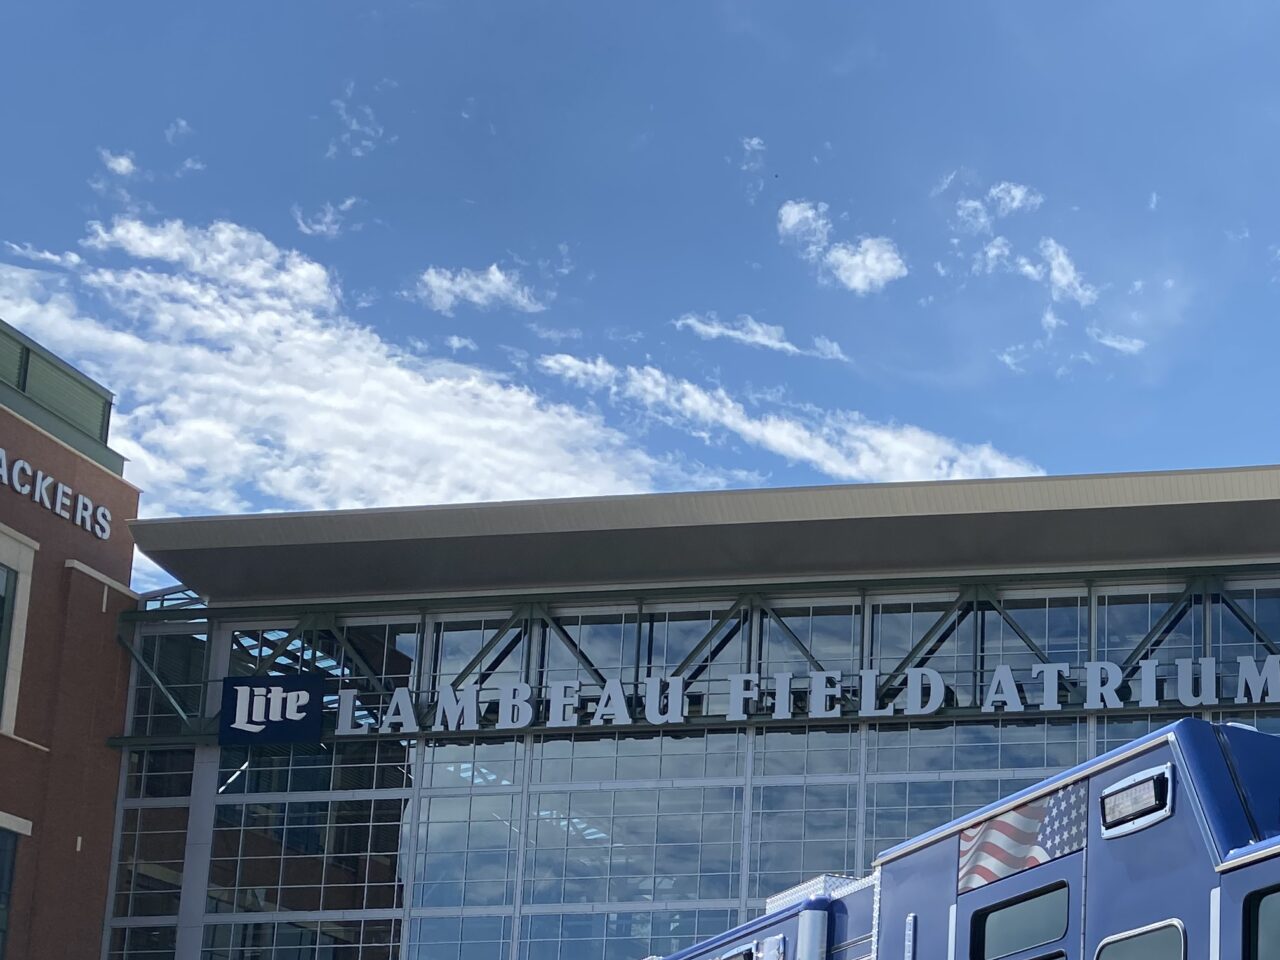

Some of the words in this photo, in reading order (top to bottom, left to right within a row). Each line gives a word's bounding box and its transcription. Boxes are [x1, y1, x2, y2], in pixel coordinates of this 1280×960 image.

[230, 686, 310, 733] Lite
[335, 676, 685, 736] LAMBEAU
[726, 667, 945, 721] FIELD
